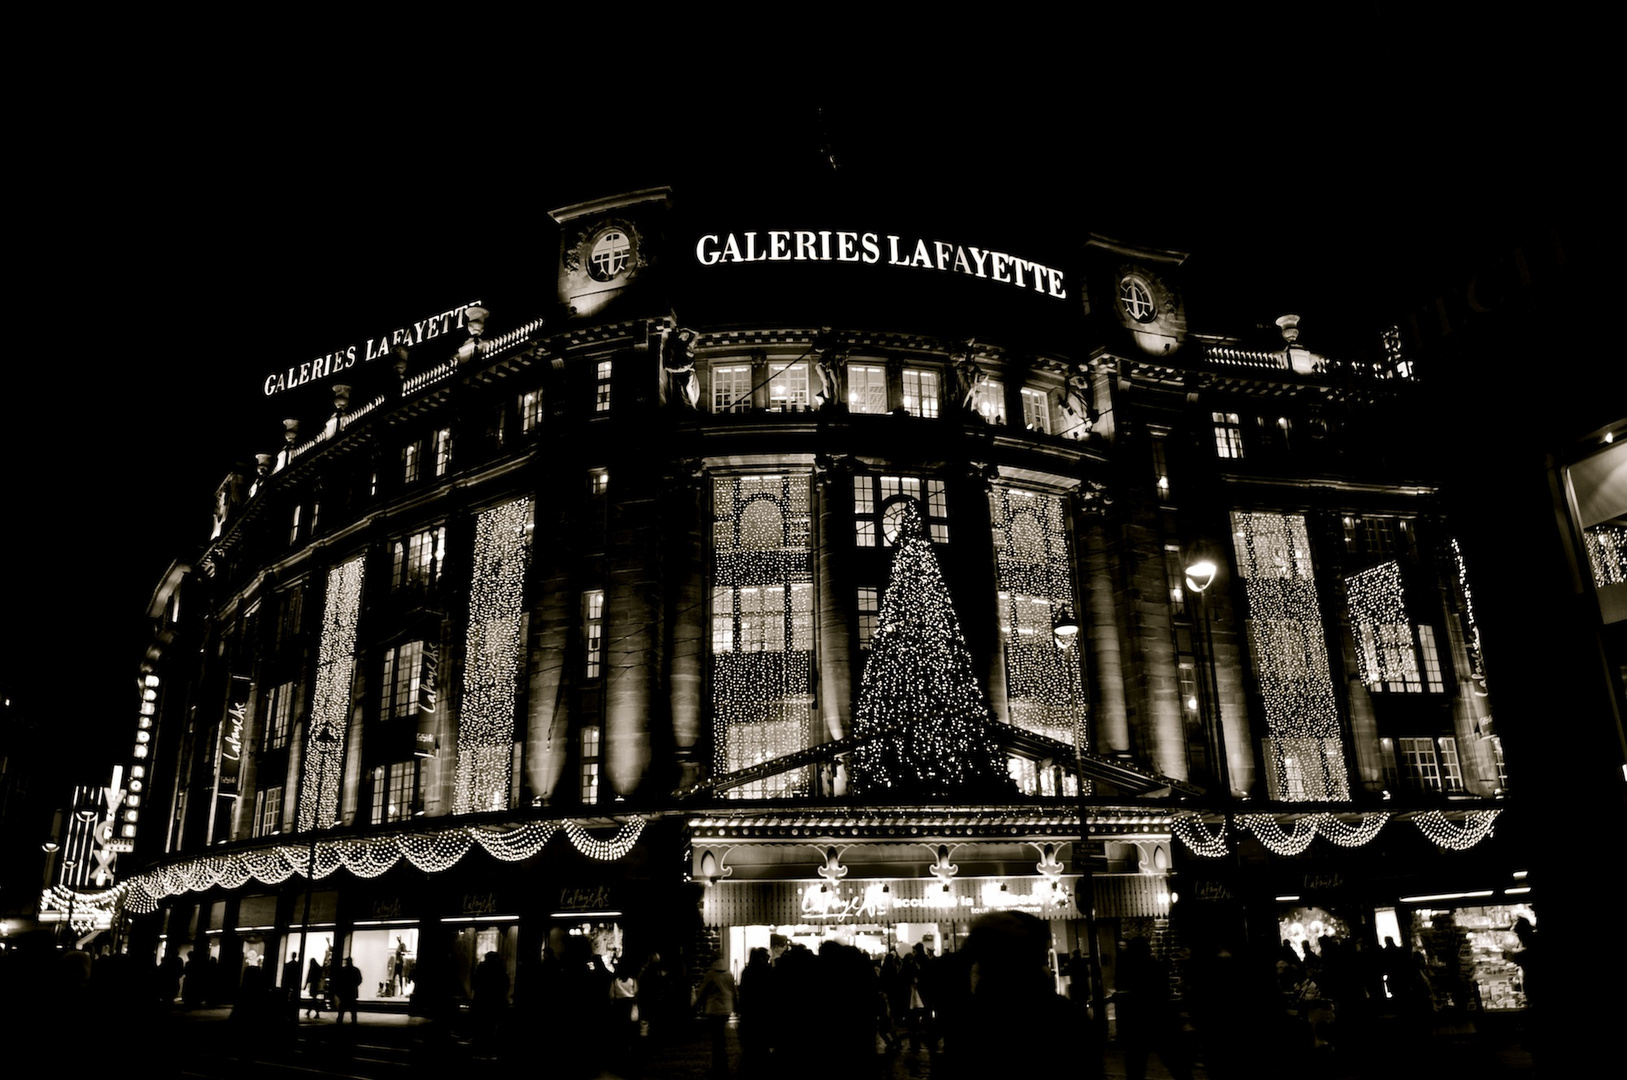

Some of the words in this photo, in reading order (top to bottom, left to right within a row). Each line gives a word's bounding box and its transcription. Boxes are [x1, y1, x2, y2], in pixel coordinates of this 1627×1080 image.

[695, 230, 880, 266] GALERIES
[886, 234, 1067, 300] LAFAYETTE
[263, 344, 357, 397] GALERIES
[363, 300, 482, 362] LAFAYETT
[105, 838, 133, 846] HOTEL
